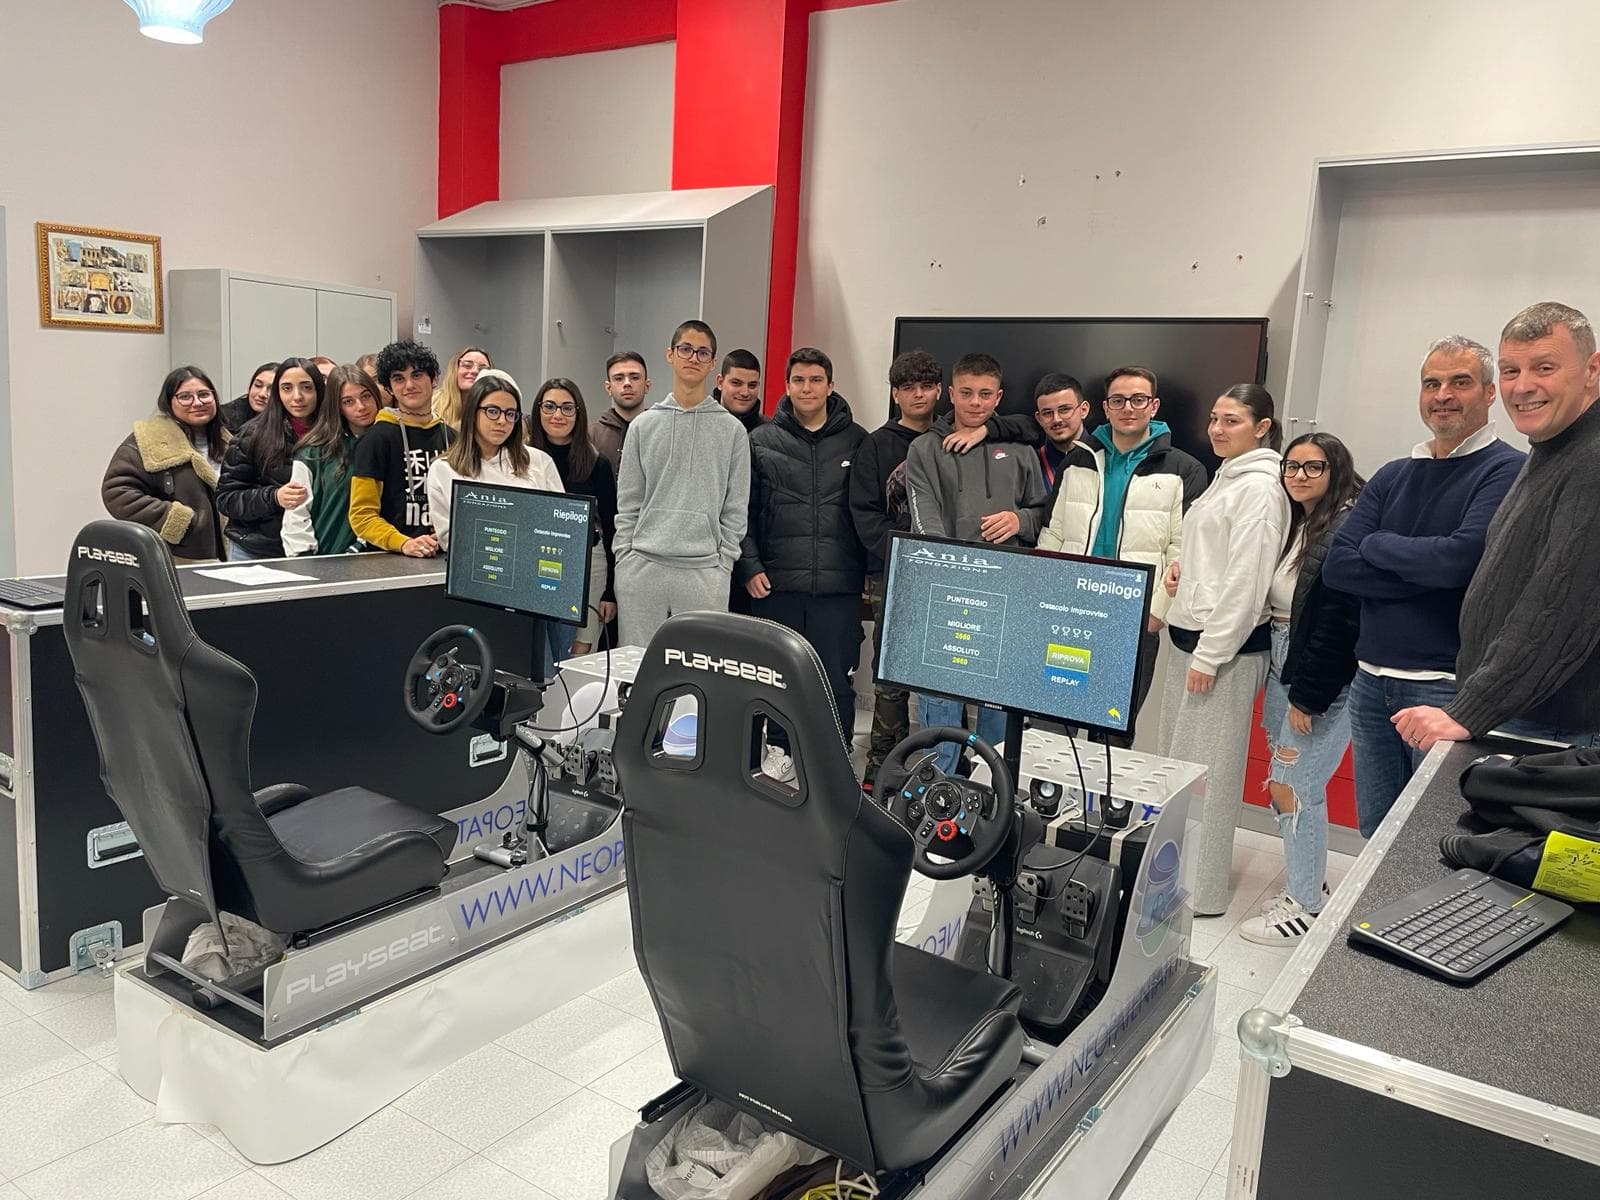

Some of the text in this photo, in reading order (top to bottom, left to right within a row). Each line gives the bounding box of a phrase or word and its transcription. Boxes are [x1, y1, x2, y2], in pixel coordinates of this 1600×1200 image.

[553, 508, 588, 524] Riepilogo
[910, 547, 988, 566] Ania
[908, 558, 988, 574] FONDAZIONE
[1076, 577, 1142, 600] Riepilogo
[946, 594, 989, 608] PUNTEGGIO
[1039, 601, 1070, 613] Ostacolo
[947, 620, 981, 632] MIGLIORE
[942, 644, 980, 656] ASSOLUTO
[1051, 652, 1085, 664] RIPROVA
[1050, 675, 1080, 687] REPLAY
